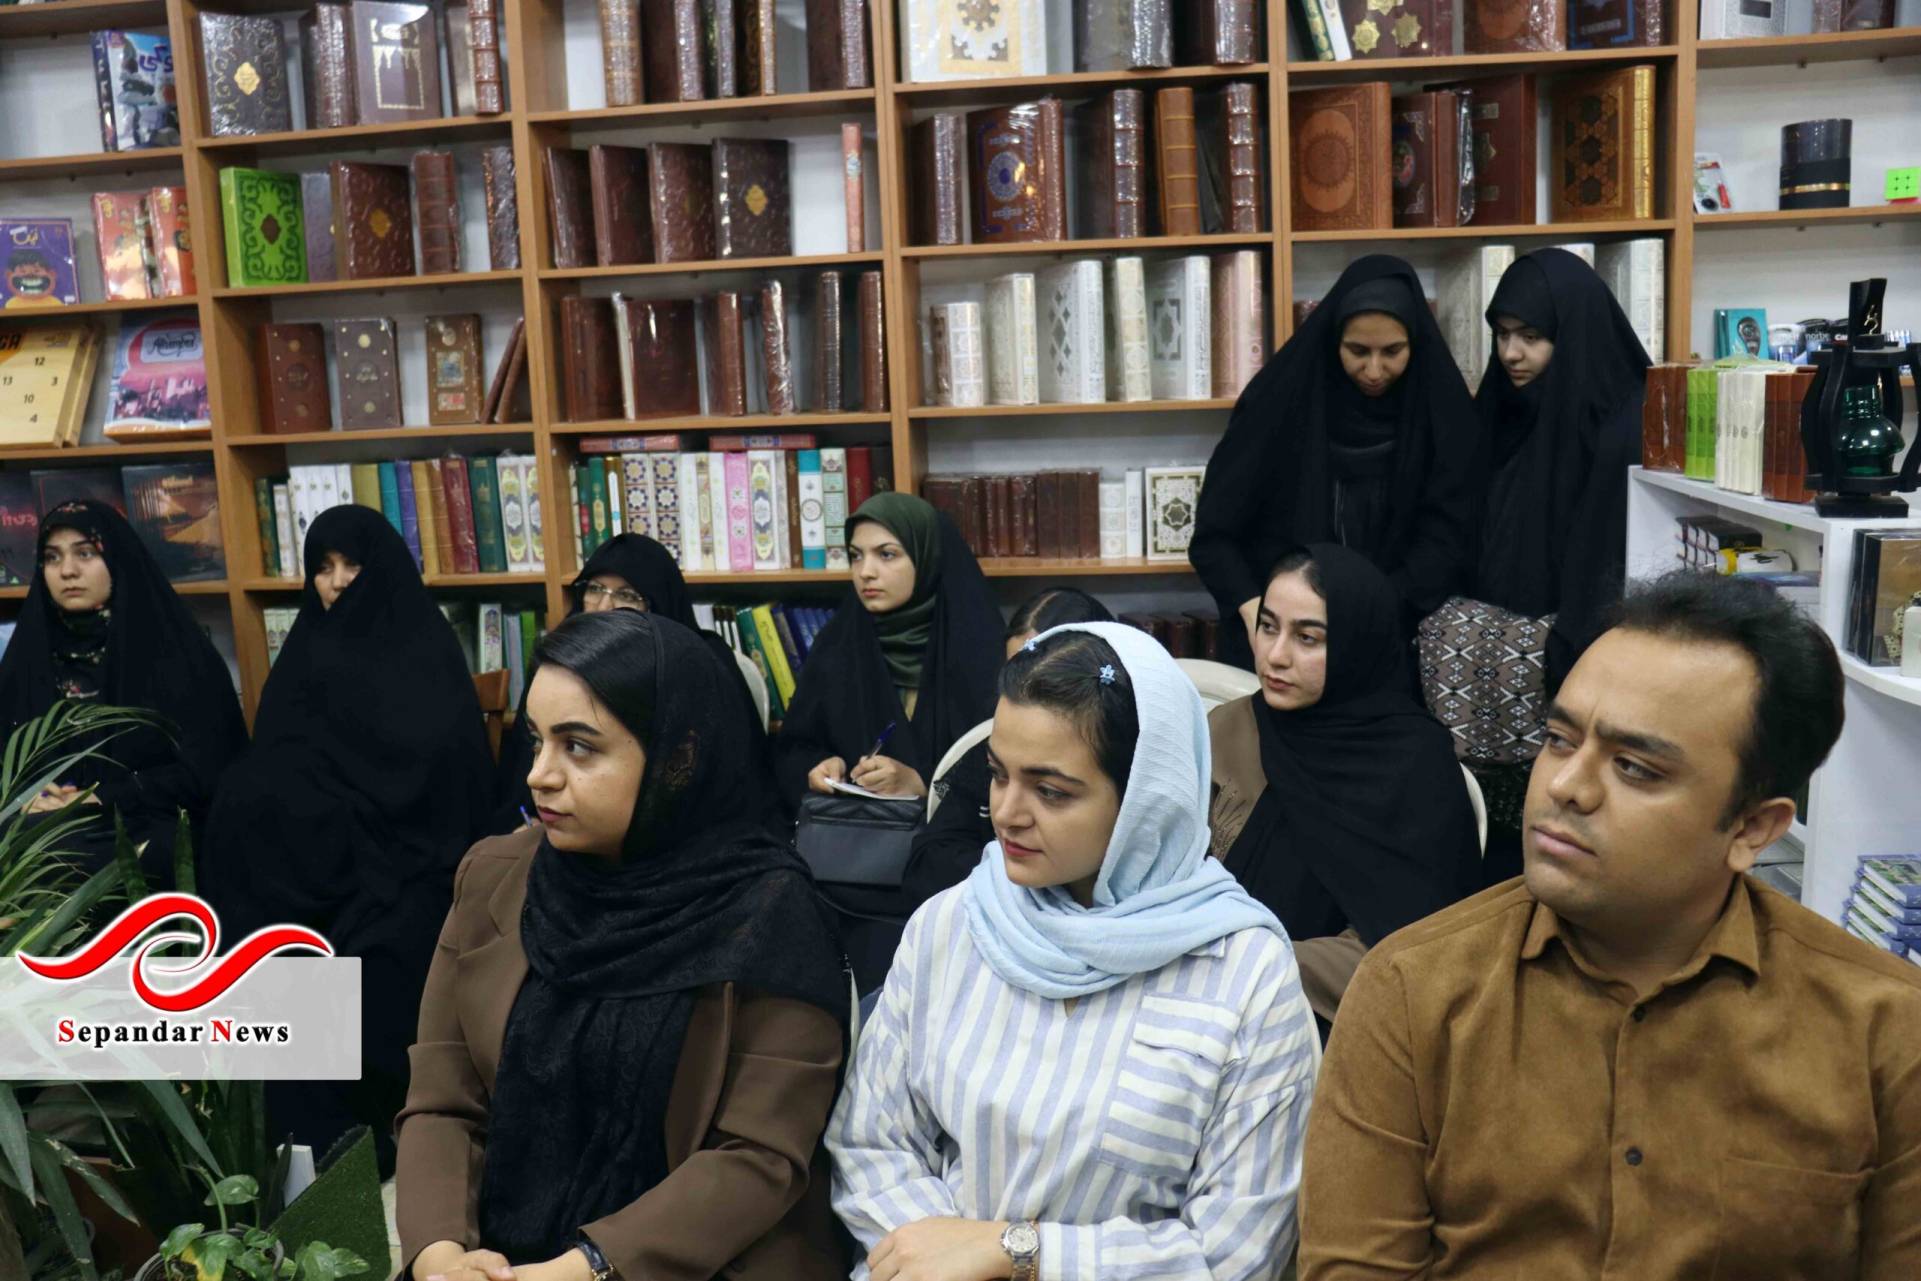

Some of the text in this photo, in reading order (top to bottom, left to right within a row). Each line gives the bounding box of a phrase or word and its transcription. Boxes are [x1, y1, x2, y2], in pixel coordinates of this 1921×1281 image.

[35, 356, 46, 367] 12
[51, 376, 58, 387] 3
[24, 393, 35, 404] 10
[30, 413, 38, 423] 4
